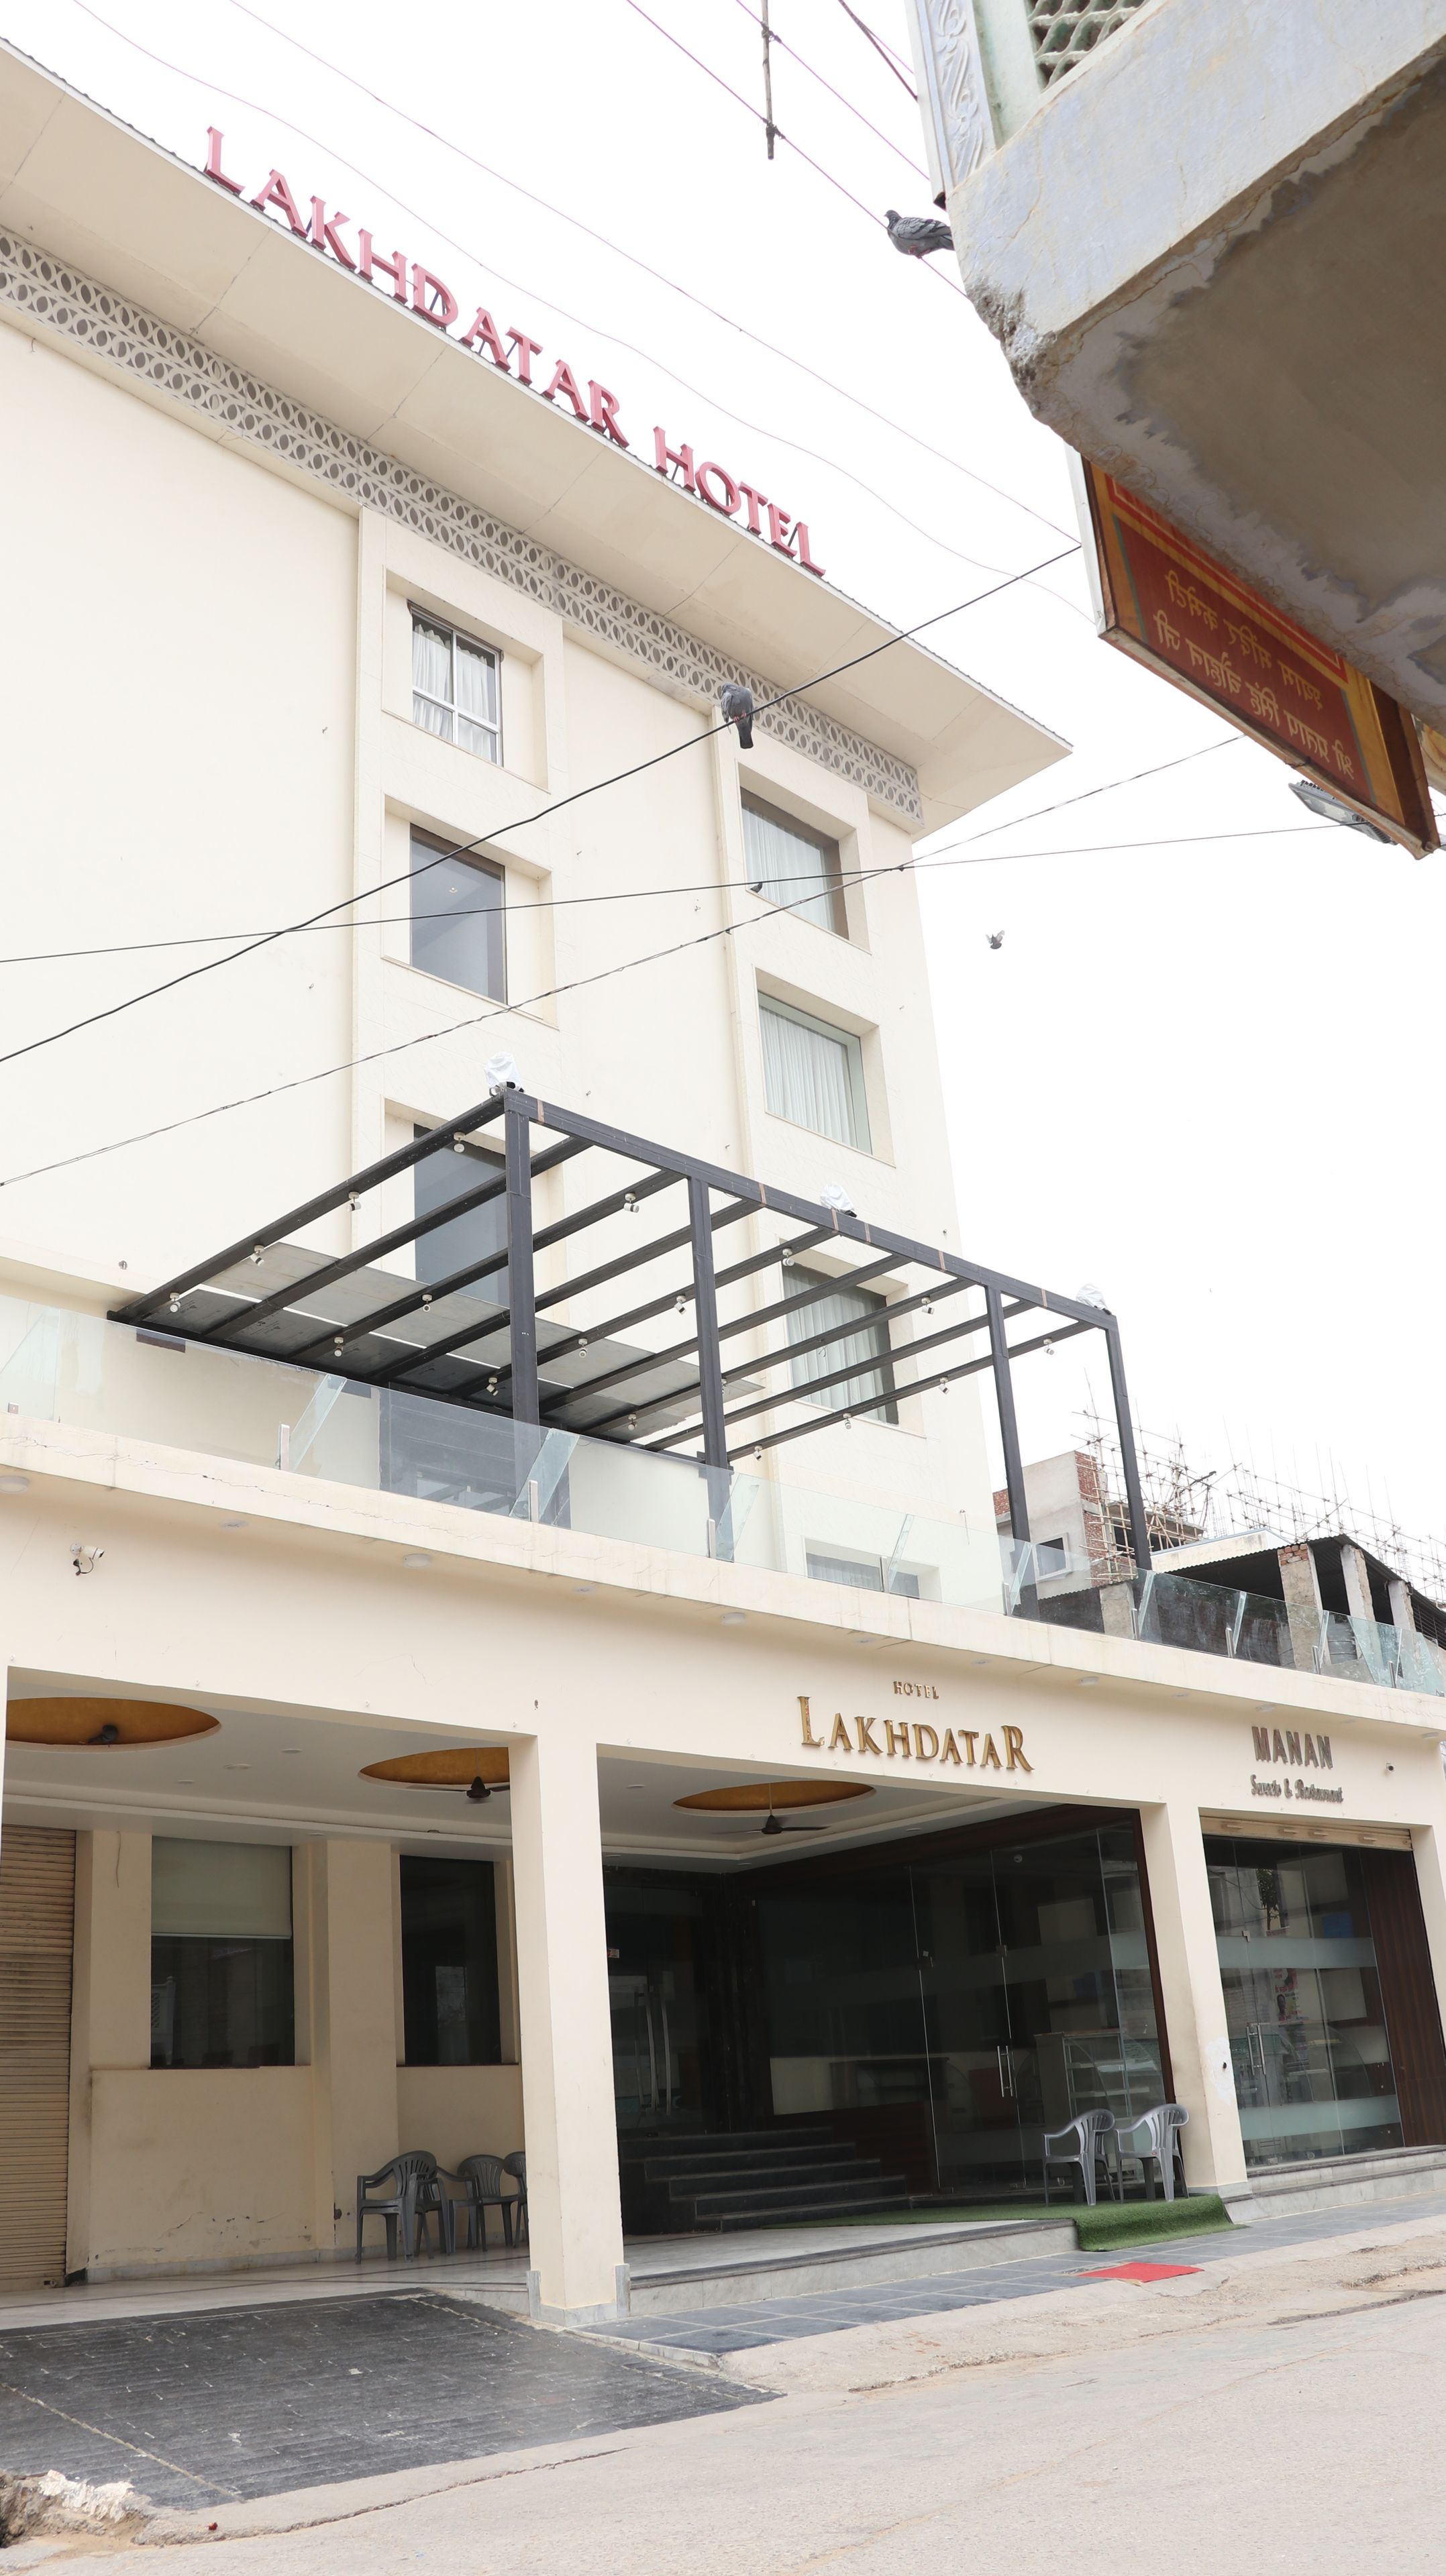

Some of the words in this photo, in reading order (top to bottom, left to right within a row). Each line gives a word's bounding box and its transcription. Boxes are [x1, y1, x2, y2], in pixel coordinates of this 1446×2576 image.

[206, 126, 629, 448] LAKHDATAR
[653, 426, 826, 576] HOTEL
[892, 1680, 939, 1700] HOTEL
[797, 1696, 1035, 1772] LAKHDATAR
[1252, 1726, 1333, 1769] MANAN
[1284, 1778, 1293, 1799] &
